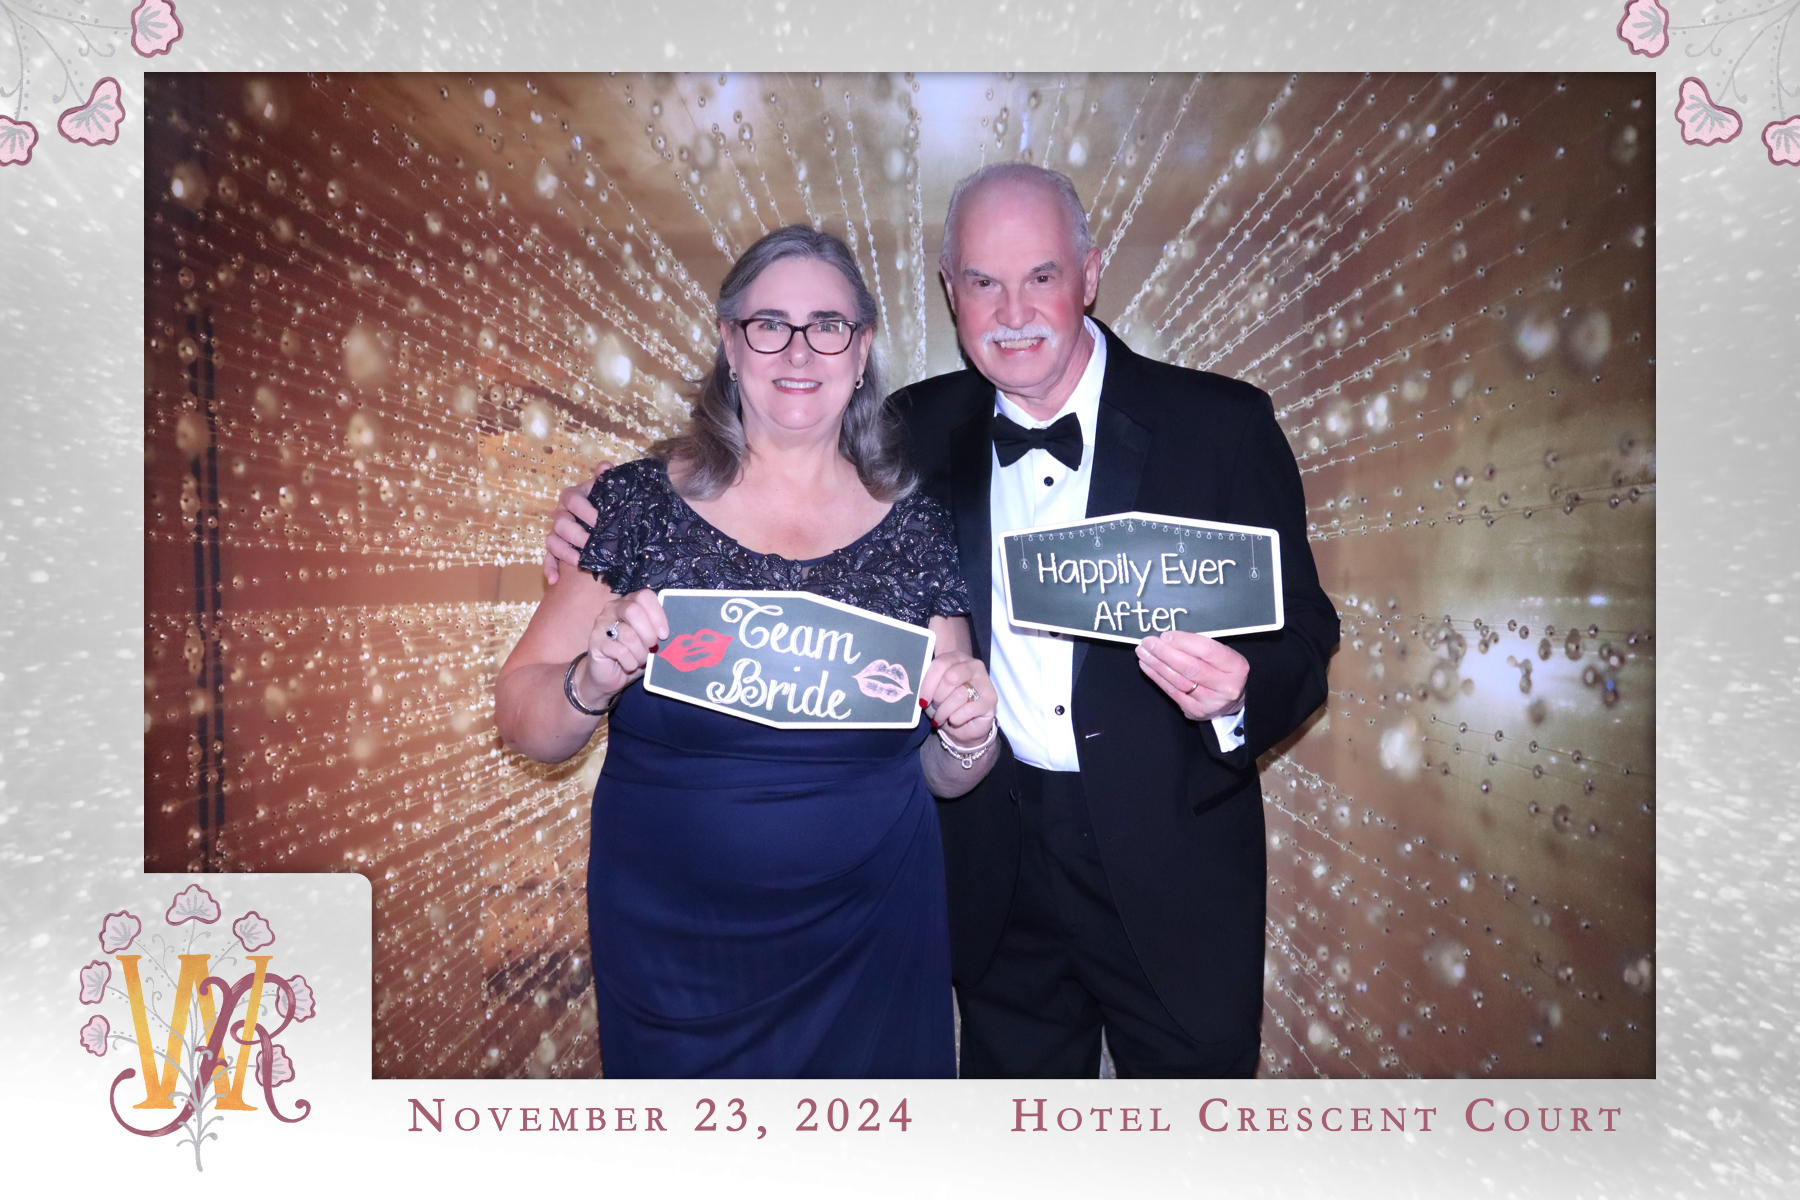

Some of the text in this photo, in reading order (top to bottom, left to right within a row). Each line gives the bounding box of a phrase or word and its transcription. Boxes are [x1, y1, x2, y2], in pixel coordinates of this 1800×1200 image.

[1036, 552, 1237, 597] Happily Ever
[720, 597, 862, 664] Team
[1093, 600, 1188, 632] After
[705, 657, 852, 720] Bride
